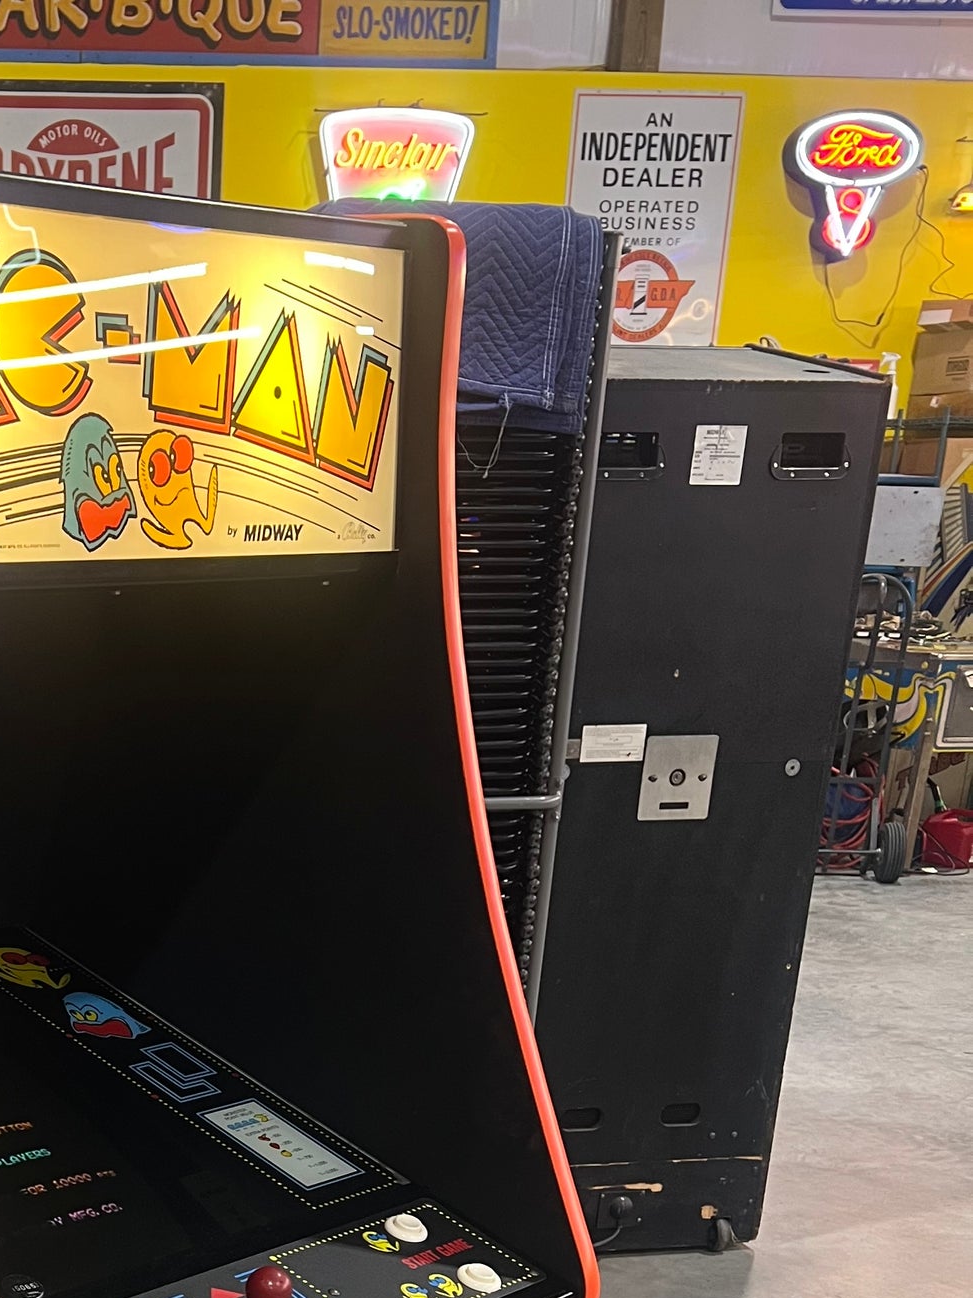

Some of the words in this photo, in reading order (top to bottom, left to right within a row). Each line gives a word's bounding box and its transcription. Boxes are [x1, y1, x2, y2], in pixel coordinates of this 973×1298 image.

[332, 4, 480, 44] SLO-SMOKED!
[645, 112, 674, 128] AN
[38, 123, 78, 149] MOTOR
[83, 125, 109, 148] OILS
[813, 123, 903, 168] Ford
[334, 126, 459, 172] Sinclair
[580, 132, 733, 163] INDEPENDENT
[602, 167, 704, 188] DEALER
[599, 199, 700, 214] OPERATED
[600, 216, 697, 231] BUSINESS
[623, 237, 662, 247] EMBER
[666, 237, 682, 247] OF
[227, 525, 238, 537] by
[243, 523, 304, 542] MIDWAY
[52, 1173, 93, 1190] 10000
[400, 1249, 442, 1271] START
[436, 1238, 475, 1258] GAME
